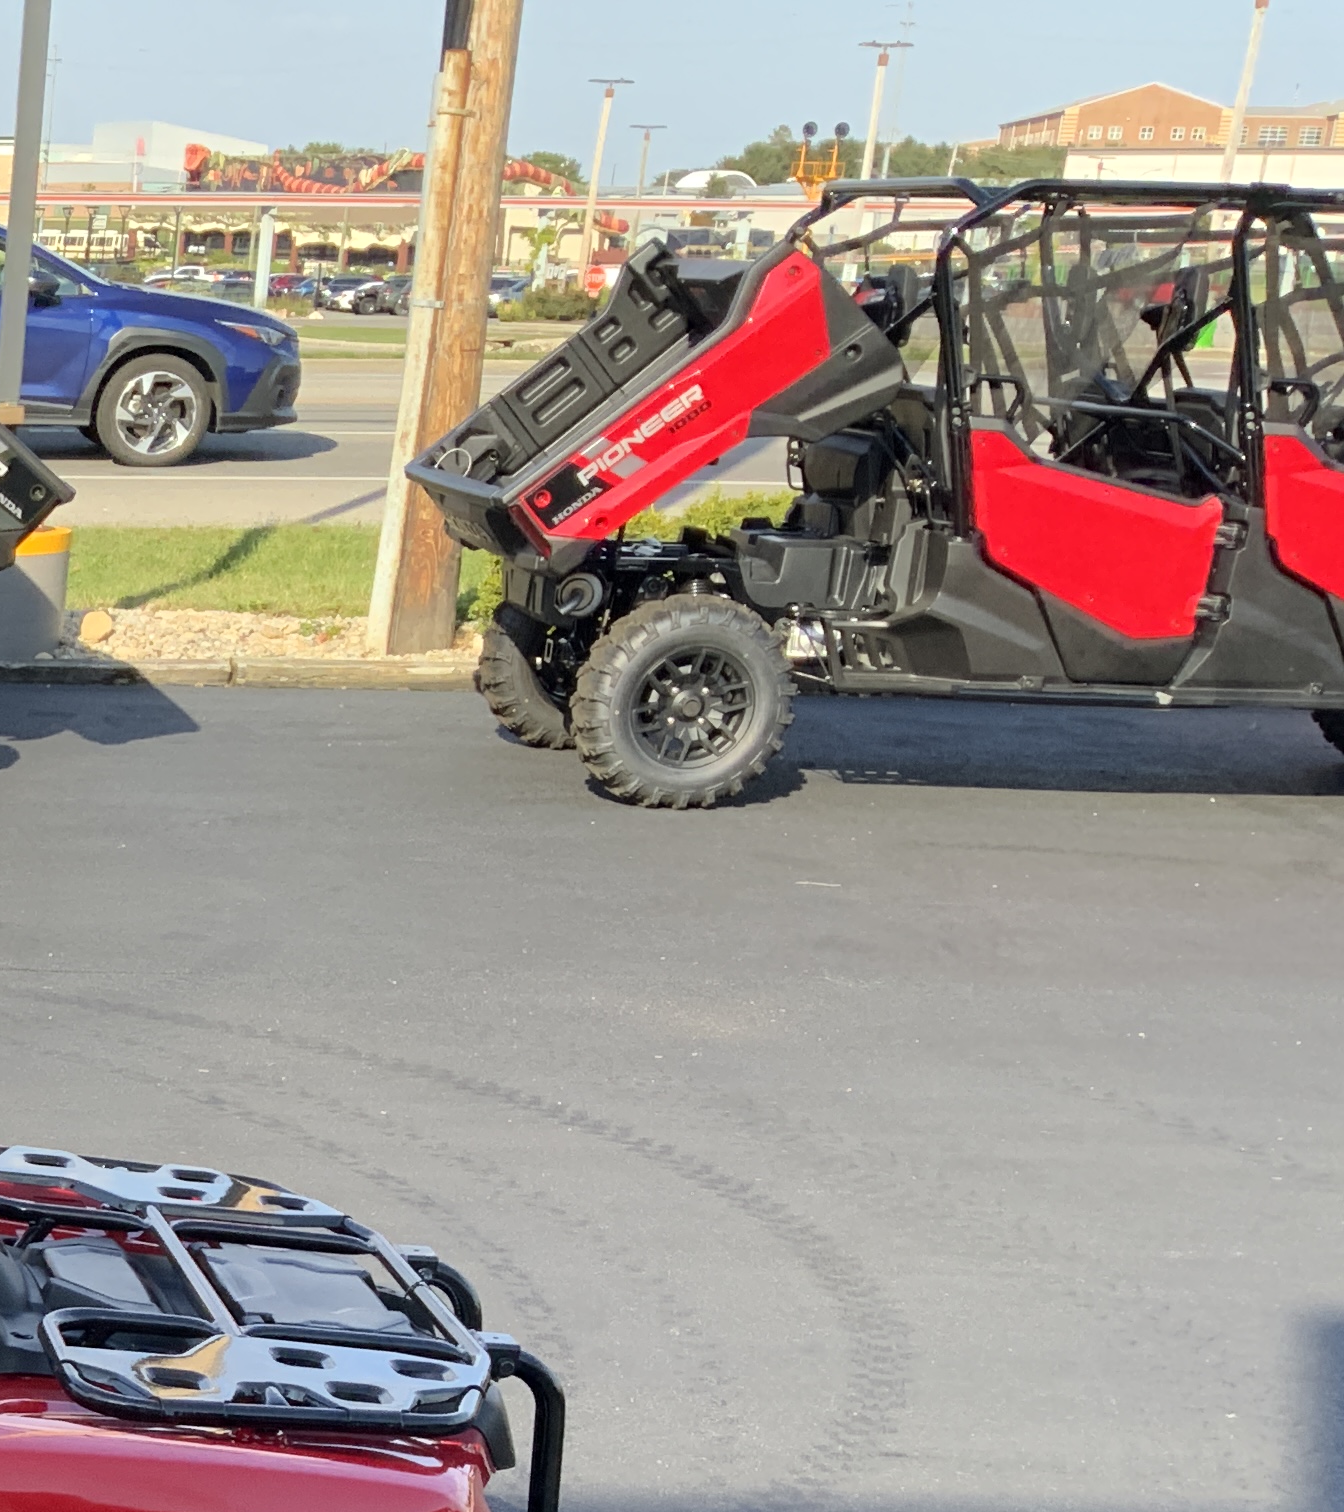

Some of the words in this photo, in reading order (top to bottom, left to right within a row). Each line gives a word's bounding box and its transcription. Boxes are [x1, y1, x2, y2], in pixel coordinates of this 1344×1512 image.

[576, 383, 705, 488] PIONEER
[668, 400, 712, 434] 1000
[551, 486, 604, 526] HONDA
